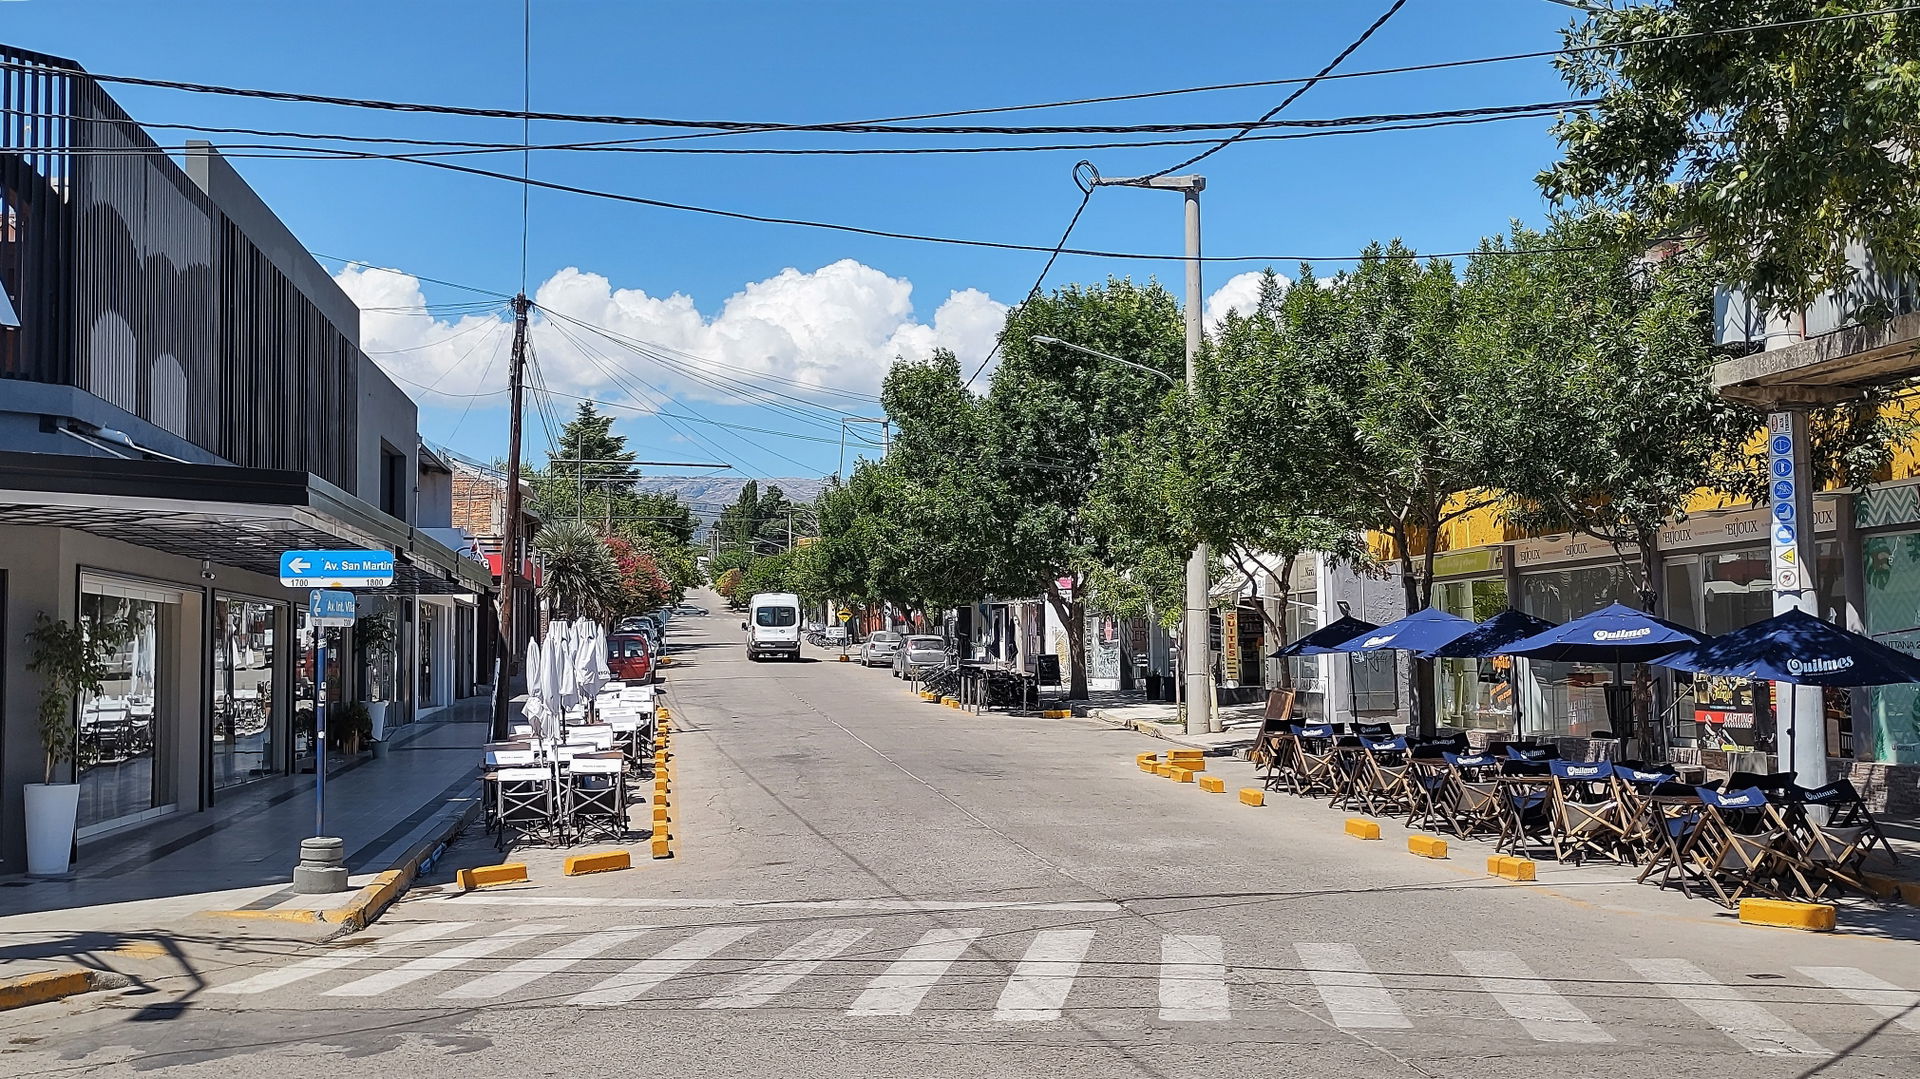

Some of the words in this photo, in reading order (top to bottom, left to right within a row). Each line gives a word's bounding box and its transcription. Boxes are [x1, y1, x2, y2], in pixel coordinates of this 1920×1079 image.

[1725, 520, 1759, 538] BIJOUX
[1662, 529, 1692, 545] BIJOUX
[1519, 549, 1541, 564] BIJOUX
[1565, 543, 1588, 558] BIJOUX
[323, 561, 339, 571] Av.
[341, 561, 360, 571] San
[291, 579, 309, 587] 1700
[366, 579, 384, 587] 1800
[1225, 612, 1237, 657] SUITES
[1593, 627, 1651, 641] Quilmes
[1787, 655, 1855, 676] Quilmes
[1724, 712, 1754, 725] KARTING
[1566, 765, 1598, 776] Quilmes
[1805, 787, 1838, 801] Quilmes
